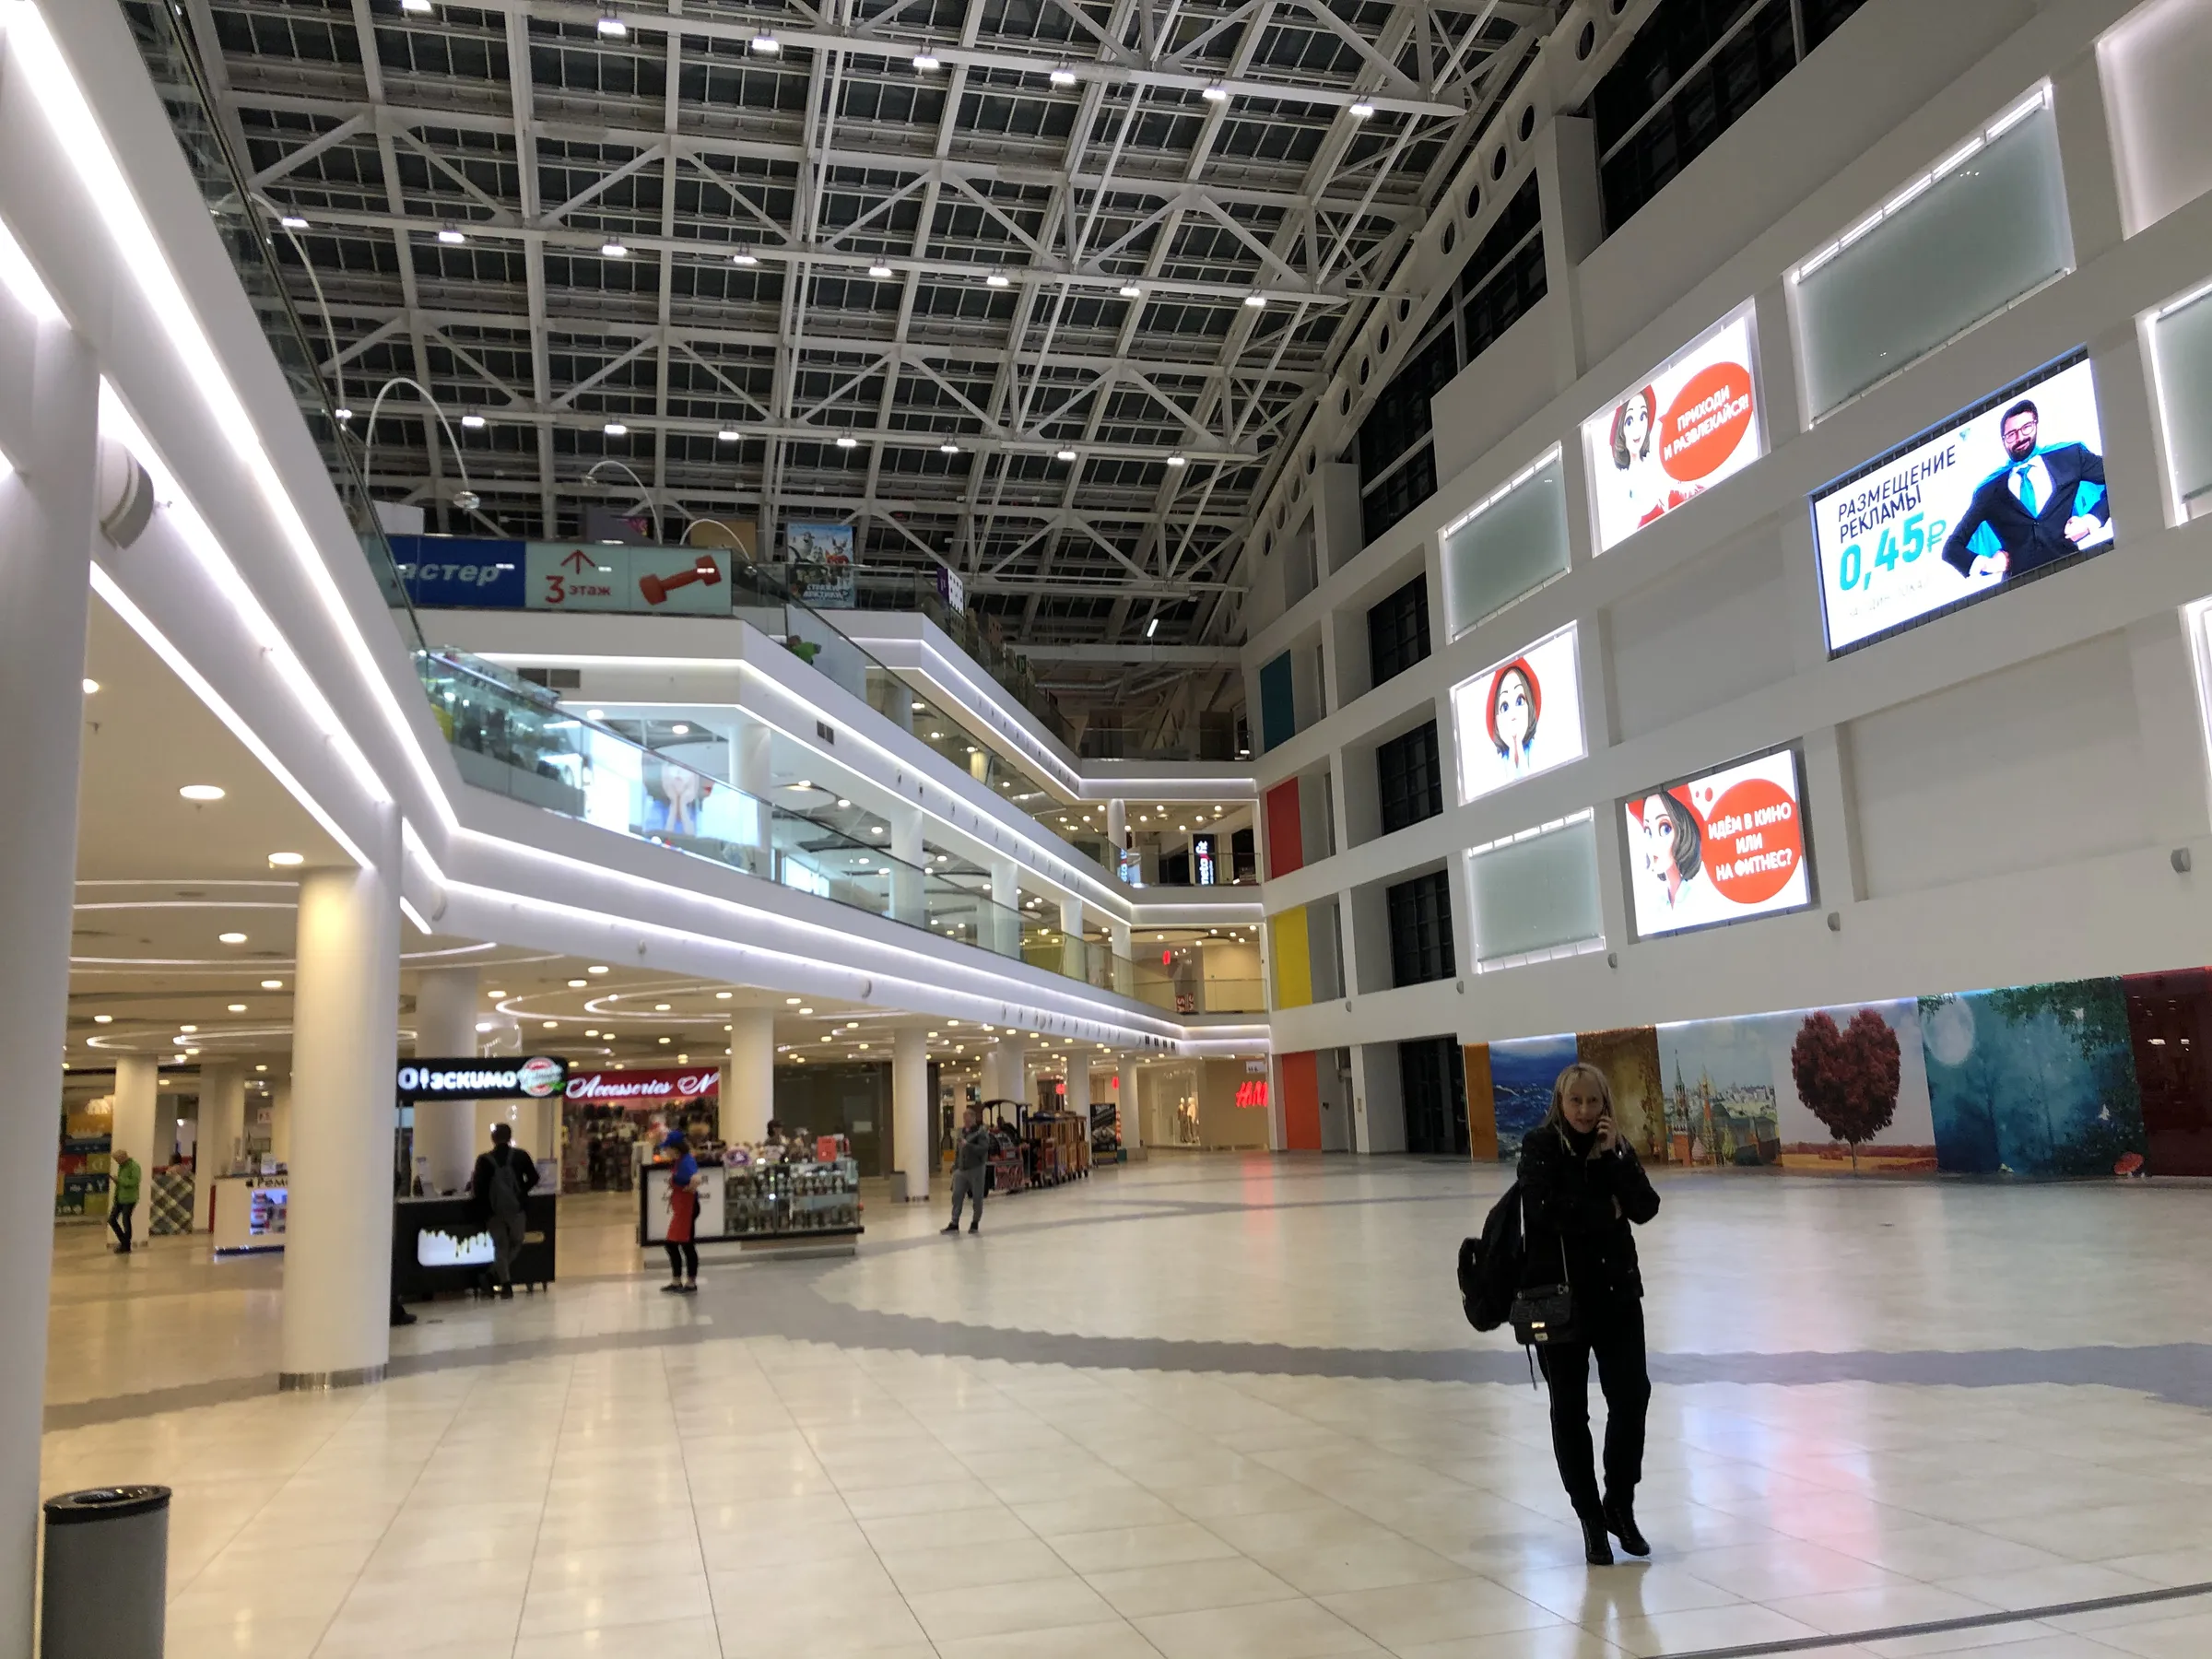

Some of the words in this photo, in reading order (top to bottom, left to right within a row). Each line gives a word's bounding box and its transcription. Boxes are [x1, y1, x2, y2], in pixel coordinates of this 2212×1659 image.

[1677, 384, 1730, 431] ПРИХОДИ
[1664, 443, 1673, 462] И
[1673, 394, 1749, 454] РАЗВЛЕКАЙСЯ!
[1839, 444, 1956, 522] РАЗМЕЩЕНИЕ
[1841, 484, 1922, 544] РЕКЛАМЫ
[397, 562, 500, 587] астер
[545, 575, 565, 604] 3
[568, 584, 611, 596] этаж
[1708, 815, 1742, 841] ИДЁМ
[1744, 812, 1753, 830] В
[1754, 801, 1792, 827] КИНО
[1735, 832, 1763, 854] ИЛИ
[1715, 863, 1734, 882] НА
[1734, 847, 1793, 877] ФИТНЕС?
[565, 1074, 673, 1099] Accessories
